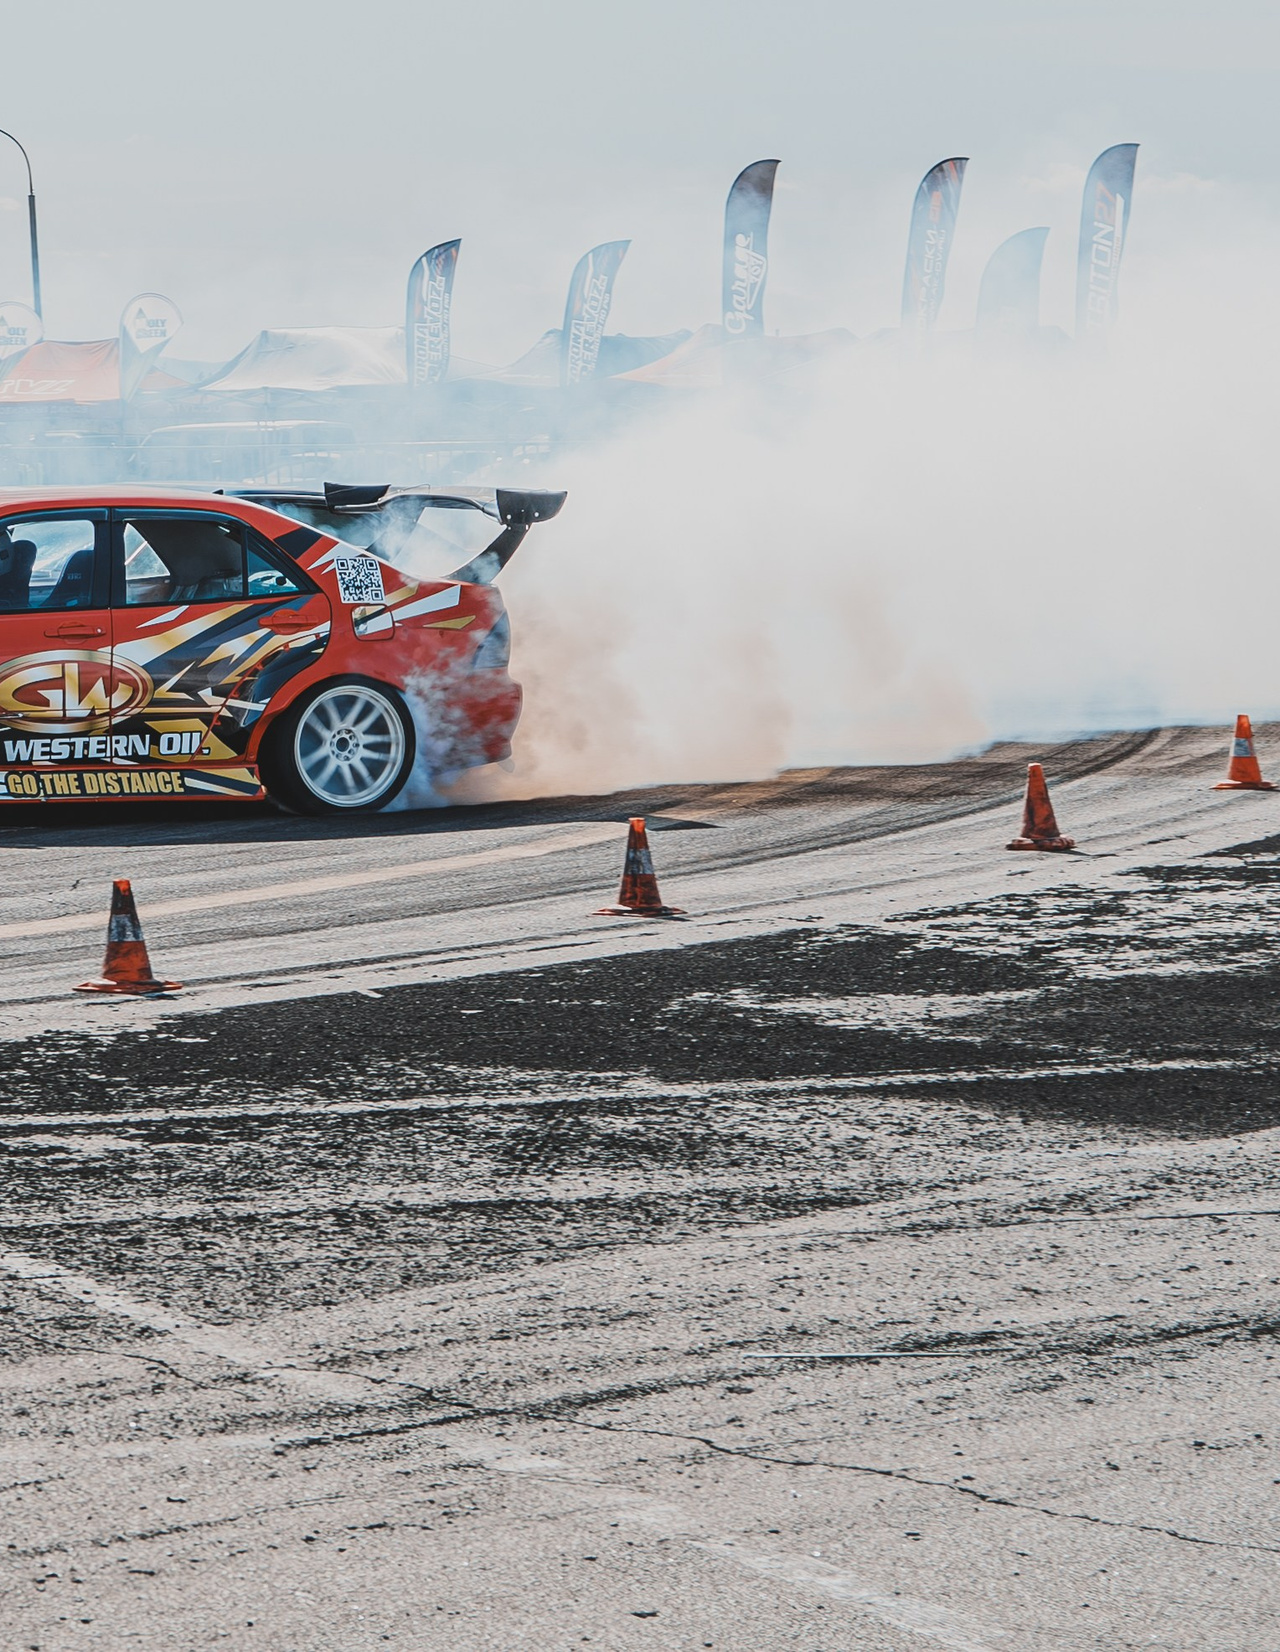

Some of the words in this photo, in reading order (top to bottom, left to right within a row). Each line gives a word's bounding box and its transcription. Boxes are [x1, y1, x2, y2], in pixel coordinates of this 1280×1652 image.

[724, 233, 755, 334] Garage
[4, 734, 150, 762] WESTERN
[159, 732, 210, 755] OIL
[7, 773, 38, 795] GO
[39, 773, 81, 795] THE
[83, 771, 185, 794] DISTANCE
